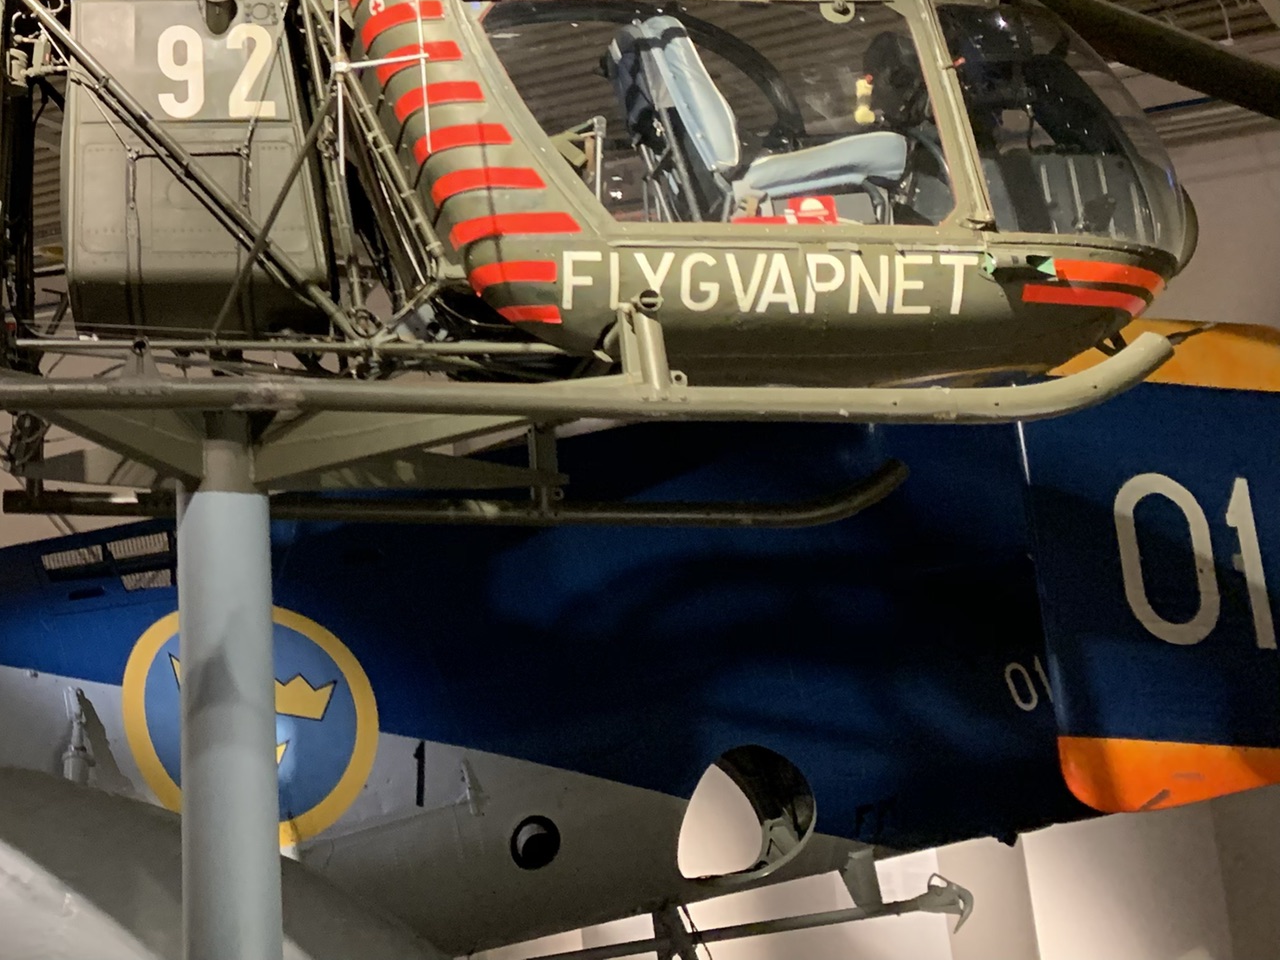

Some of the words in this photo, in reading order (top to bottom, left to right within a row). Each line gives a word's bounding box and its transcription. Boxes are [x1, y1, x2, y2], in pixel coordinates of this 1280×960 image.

[157, 23, 276, 118] 92
[562, 250, 979, 315] FLYGVAPNET
[1114, 472, 1278, 650] 01
